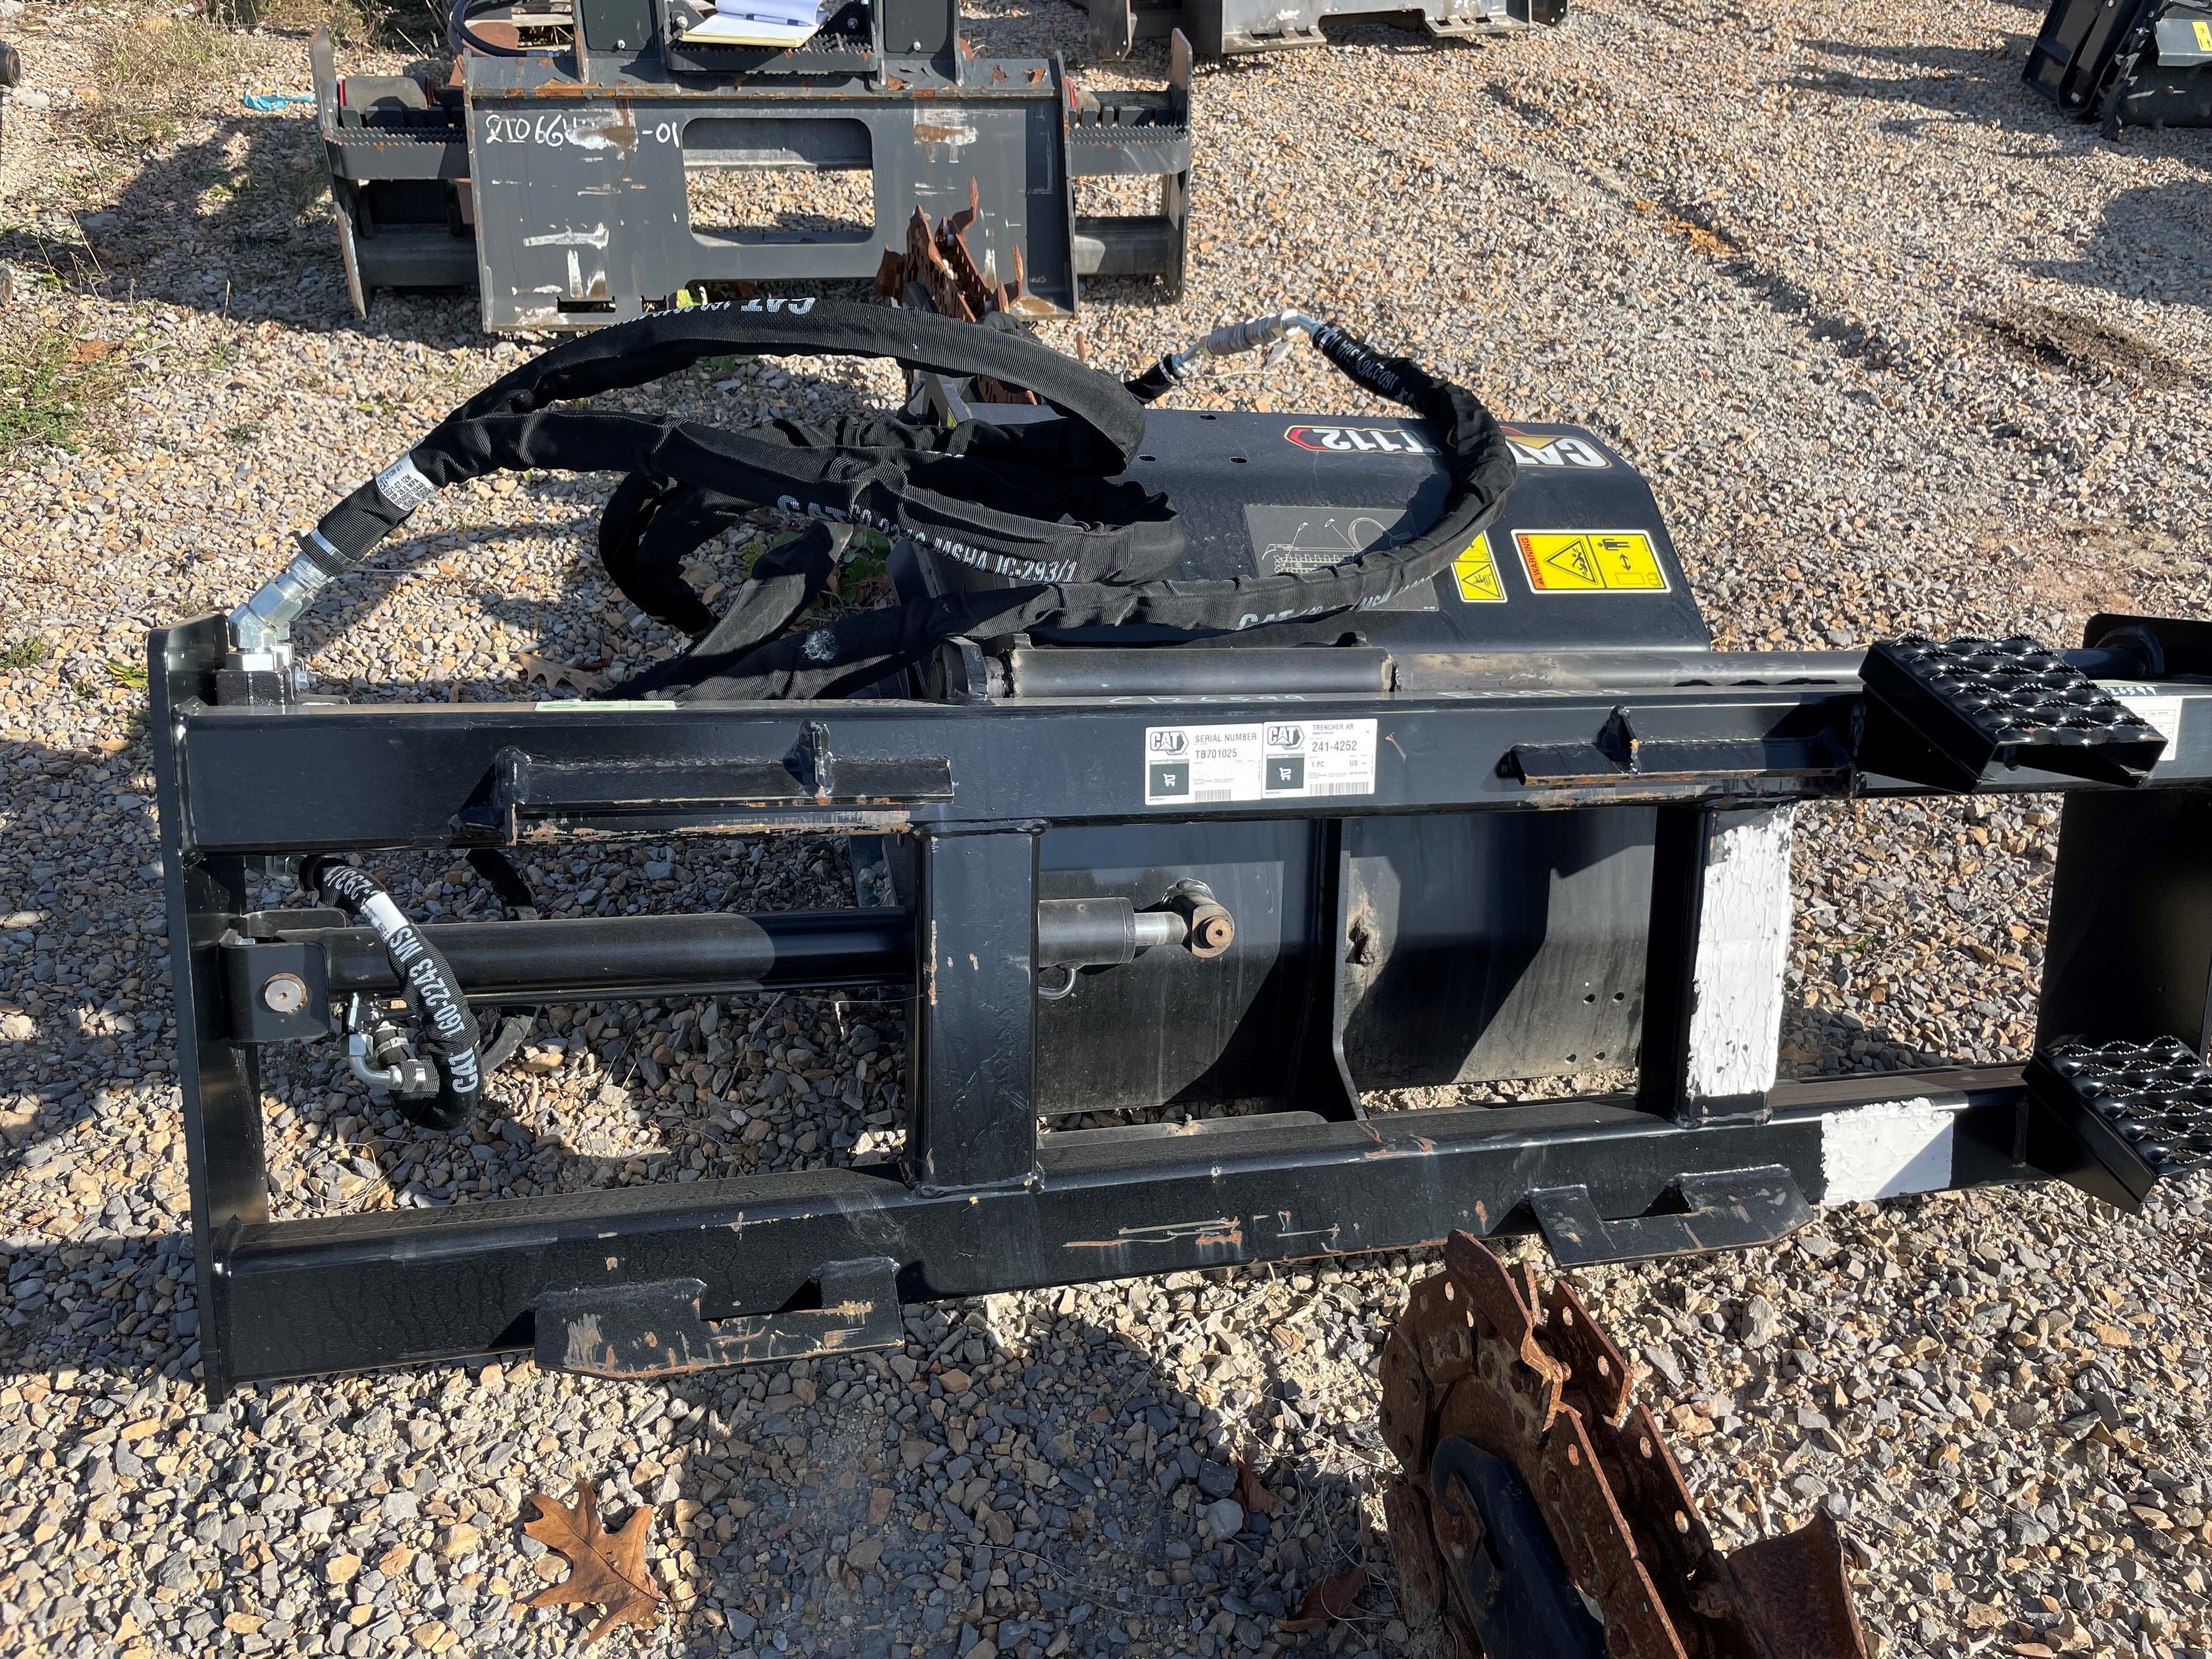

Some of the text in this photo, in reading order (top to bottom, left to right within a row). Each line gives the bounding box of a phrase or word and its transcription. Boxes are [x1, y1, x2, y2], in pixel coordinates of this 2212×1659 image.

[1312, 428, 1437, 454] T112
[379, 481, 390, 491] CAT
[389, 493, 398, 501] WP
[408, 478, 420, 488] MPA
[1522, 538, 1541, 575] WARNING
[1150, 731, 1181, 751] CAT
[1195, 732, 1257, 743] SERIAL NUMBER
[1267, 726, 1296, 745] CAT
[1195, 748, 1238, 759] TB701025
[1312, 740, 1357, 752] 241-4252
[324, 866, 381, 905] -293/1
[389, 927, 478, 1093] CAT 160-2243 MS
